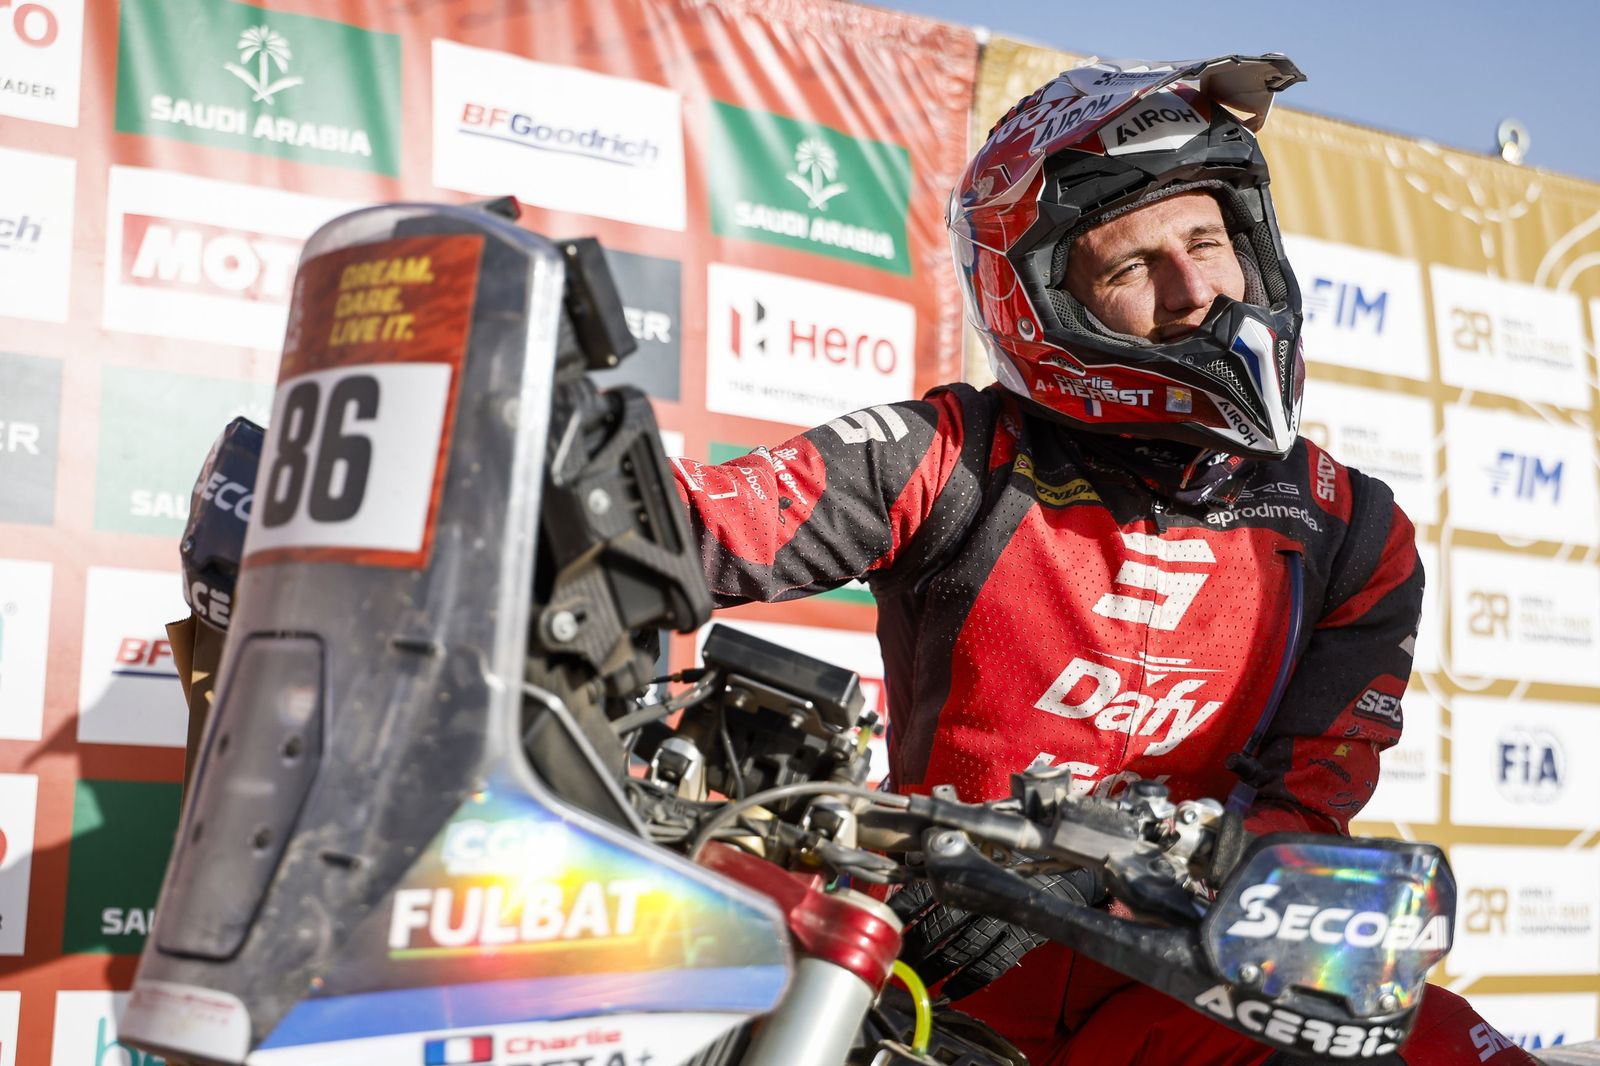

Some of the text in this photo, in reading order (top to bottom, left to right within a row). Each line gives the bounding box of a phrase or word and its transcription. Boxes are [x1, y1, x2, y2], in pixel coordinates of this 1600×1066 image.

[0, 78, 56, 100] ADER
[150, 94, 372, 157] SAUDI ARABIA
[461, 101, 660, 162] BFGoodrich
[1034, 94, 1114, 148] AIROH
[1116, 106, 1201, 146] AIROH
[734, 201, 897, 260] SAUDI ARABIA
[788, 319, 897, 376] Hero
[1035, 378, 1154, 407] A+ HERBST
[1053, 373, 1113, 390] Charlie
[0, 421, 40, 455] R
[1217, 400, 1259, 447] AIROH
[261, 374, 381, 530] 86
[1033, 656, 1225, 757] Dafy
[388, 879, 650, 950] FULBAT
[505, 1029, 622, 1054] Charlie
